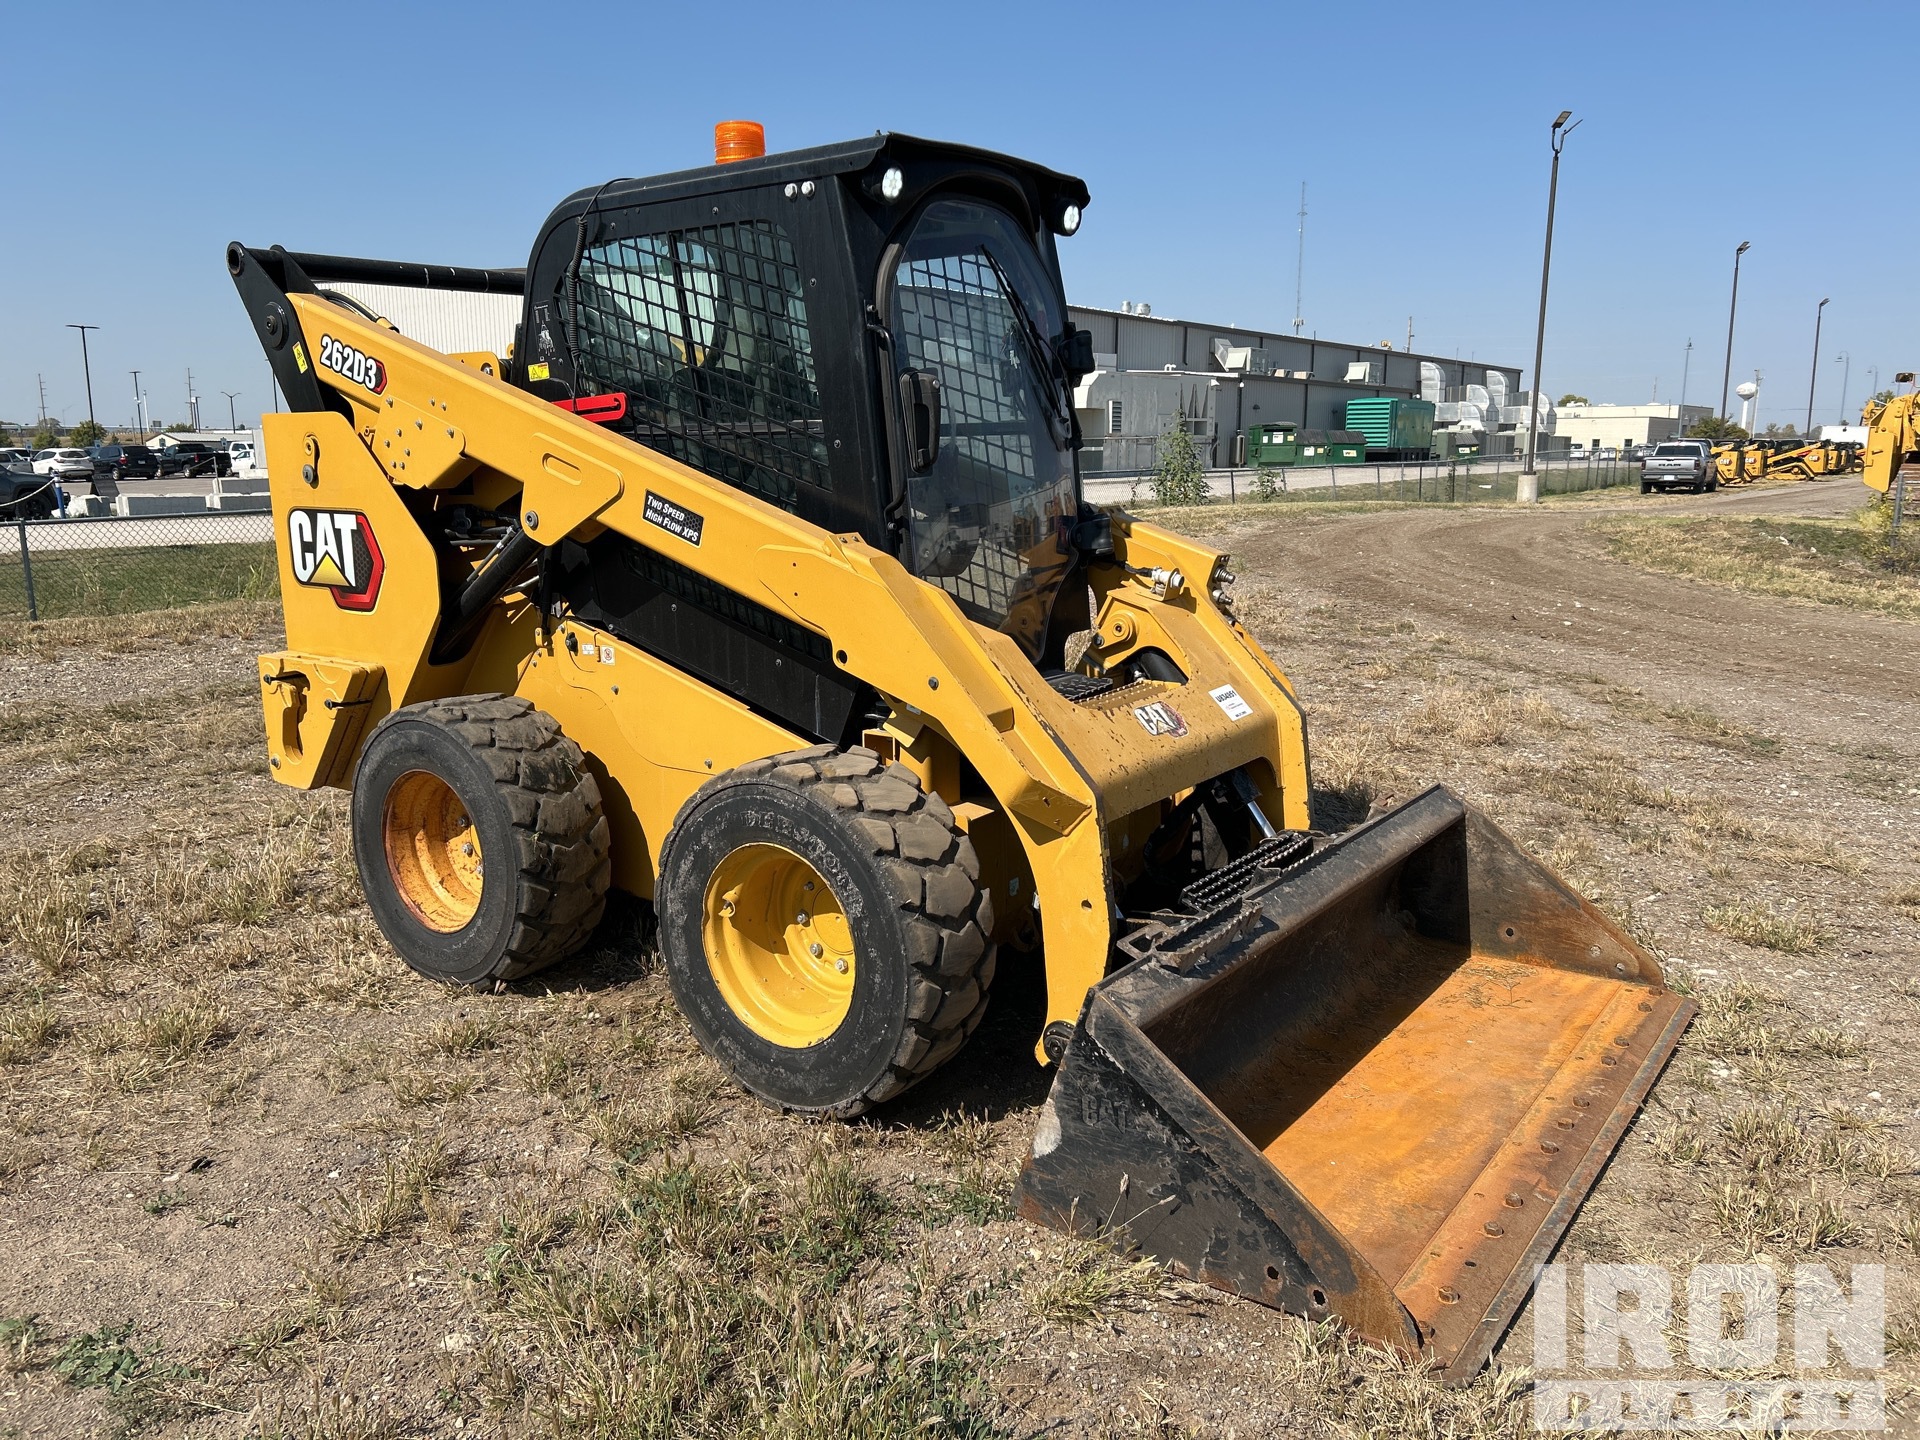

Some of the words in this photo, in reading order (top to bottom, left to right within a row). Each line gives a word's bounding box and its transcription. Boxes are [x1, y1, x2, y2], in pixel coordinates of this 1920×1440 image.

[320, 335, 377, 390] 262D3
[289, 510, 357, 587] CAT
[682, 526, 699, 542] XPS
[1134, 701, 1177, 735] CAT
[1081, 1094, 1129, 1134] CAT
